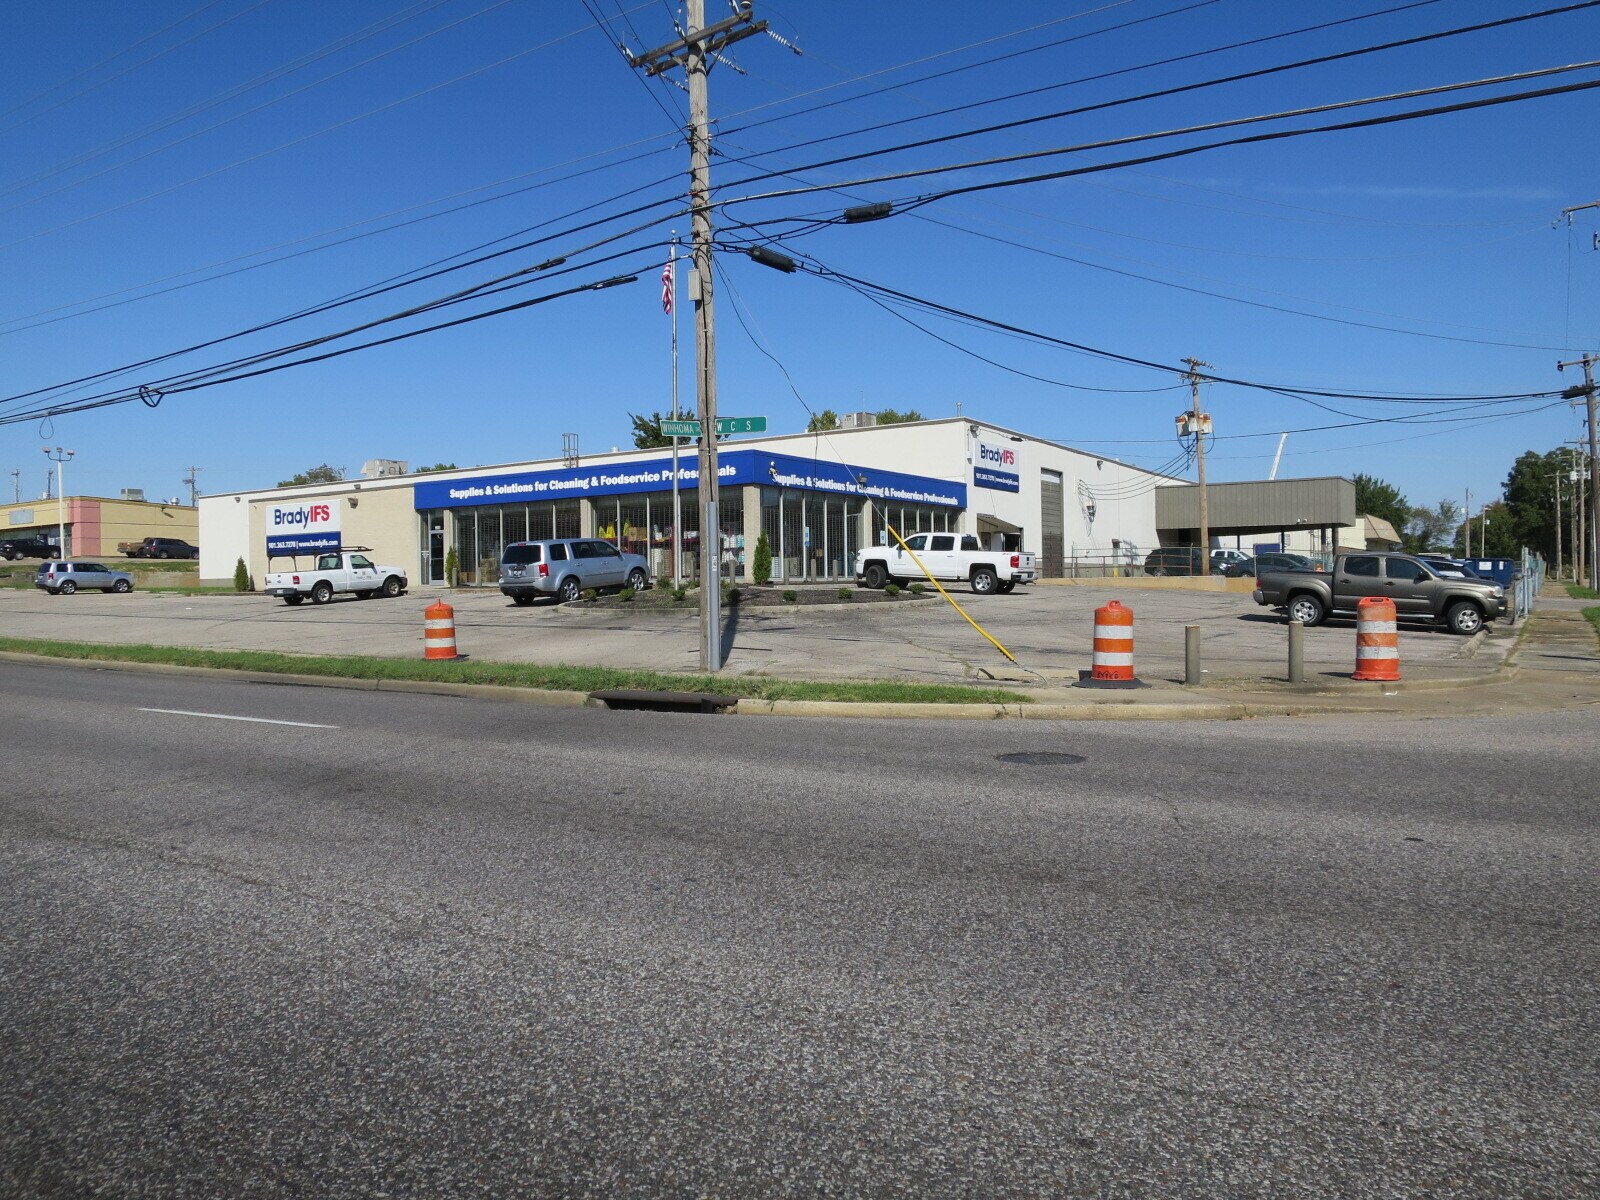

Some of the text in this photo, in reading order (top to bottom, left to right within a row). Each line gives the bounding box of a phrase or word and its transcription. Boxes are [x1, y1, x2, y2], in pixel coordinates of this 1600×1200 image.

[716, 420, 752, 432] W C S
[981, 444, 1015, 467] BradyIFS
[449, 487, 484, 499] Supplies
[485, 485, 493, 495] &
[493, 483, 533, 495] Solutions
[535, 481, 548, 492] for
[549, 478, 590, 490] Cleaning
[591, 476, 599, 487] &
[600, 471, 660, 486] Foodservice
[772, 474, 805, 487] Supplies
[805, 476, 812, 487] &
[813, 477, 846, 491] Solutions
[845, 481, 857, 493] for
[884, 487, 890, 497] &
[890, 487, 923, 502] Foodservice
[923, 492, 959, 506] Professionals
[274, 504, 330, 529] BradyIFS
